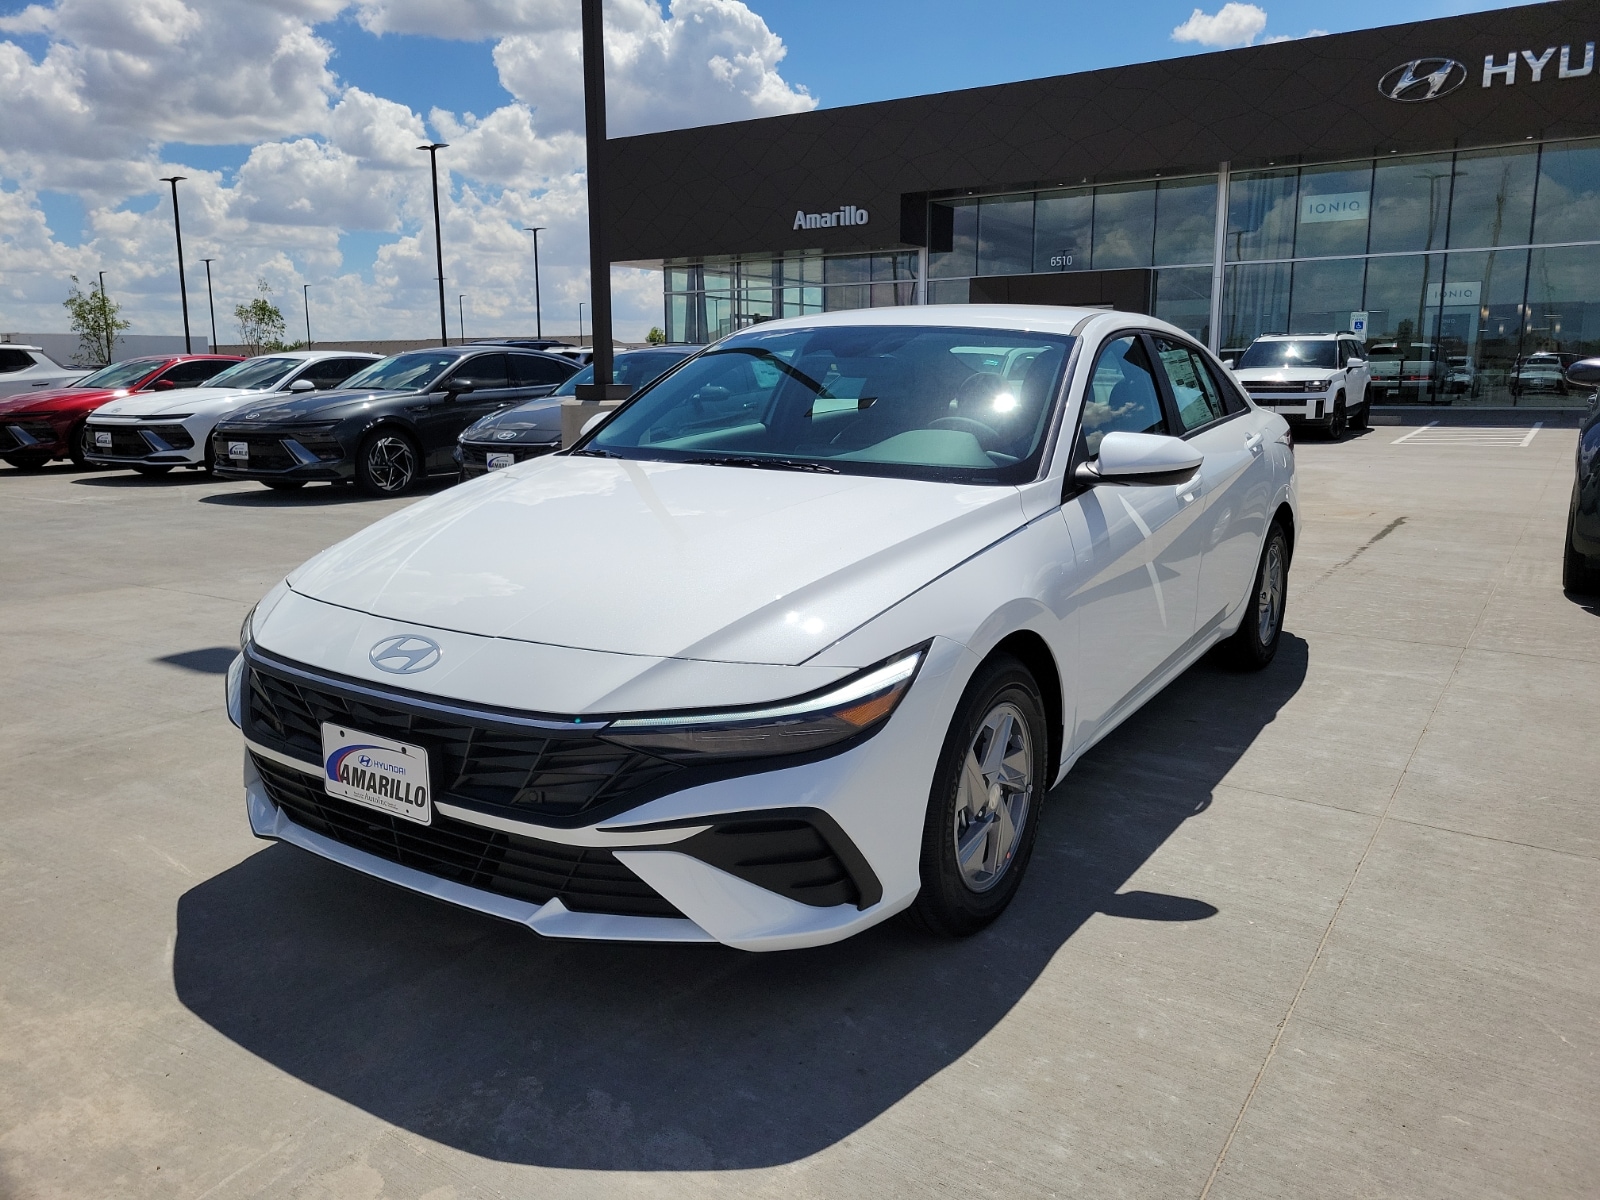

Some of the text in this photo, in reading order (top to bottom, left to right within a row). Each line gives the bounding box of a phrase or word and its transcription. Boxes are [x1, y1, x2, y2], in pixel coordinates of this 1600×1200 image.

[1309, 201, 1360, 214] IONIQ
[793, 205, 869, 231] Amarillo
[1050, 255, 1073, 267] 6510
[374, 761, 406, 775] HYUNDAI
[340, 763, 427, 808] AMARILLO
